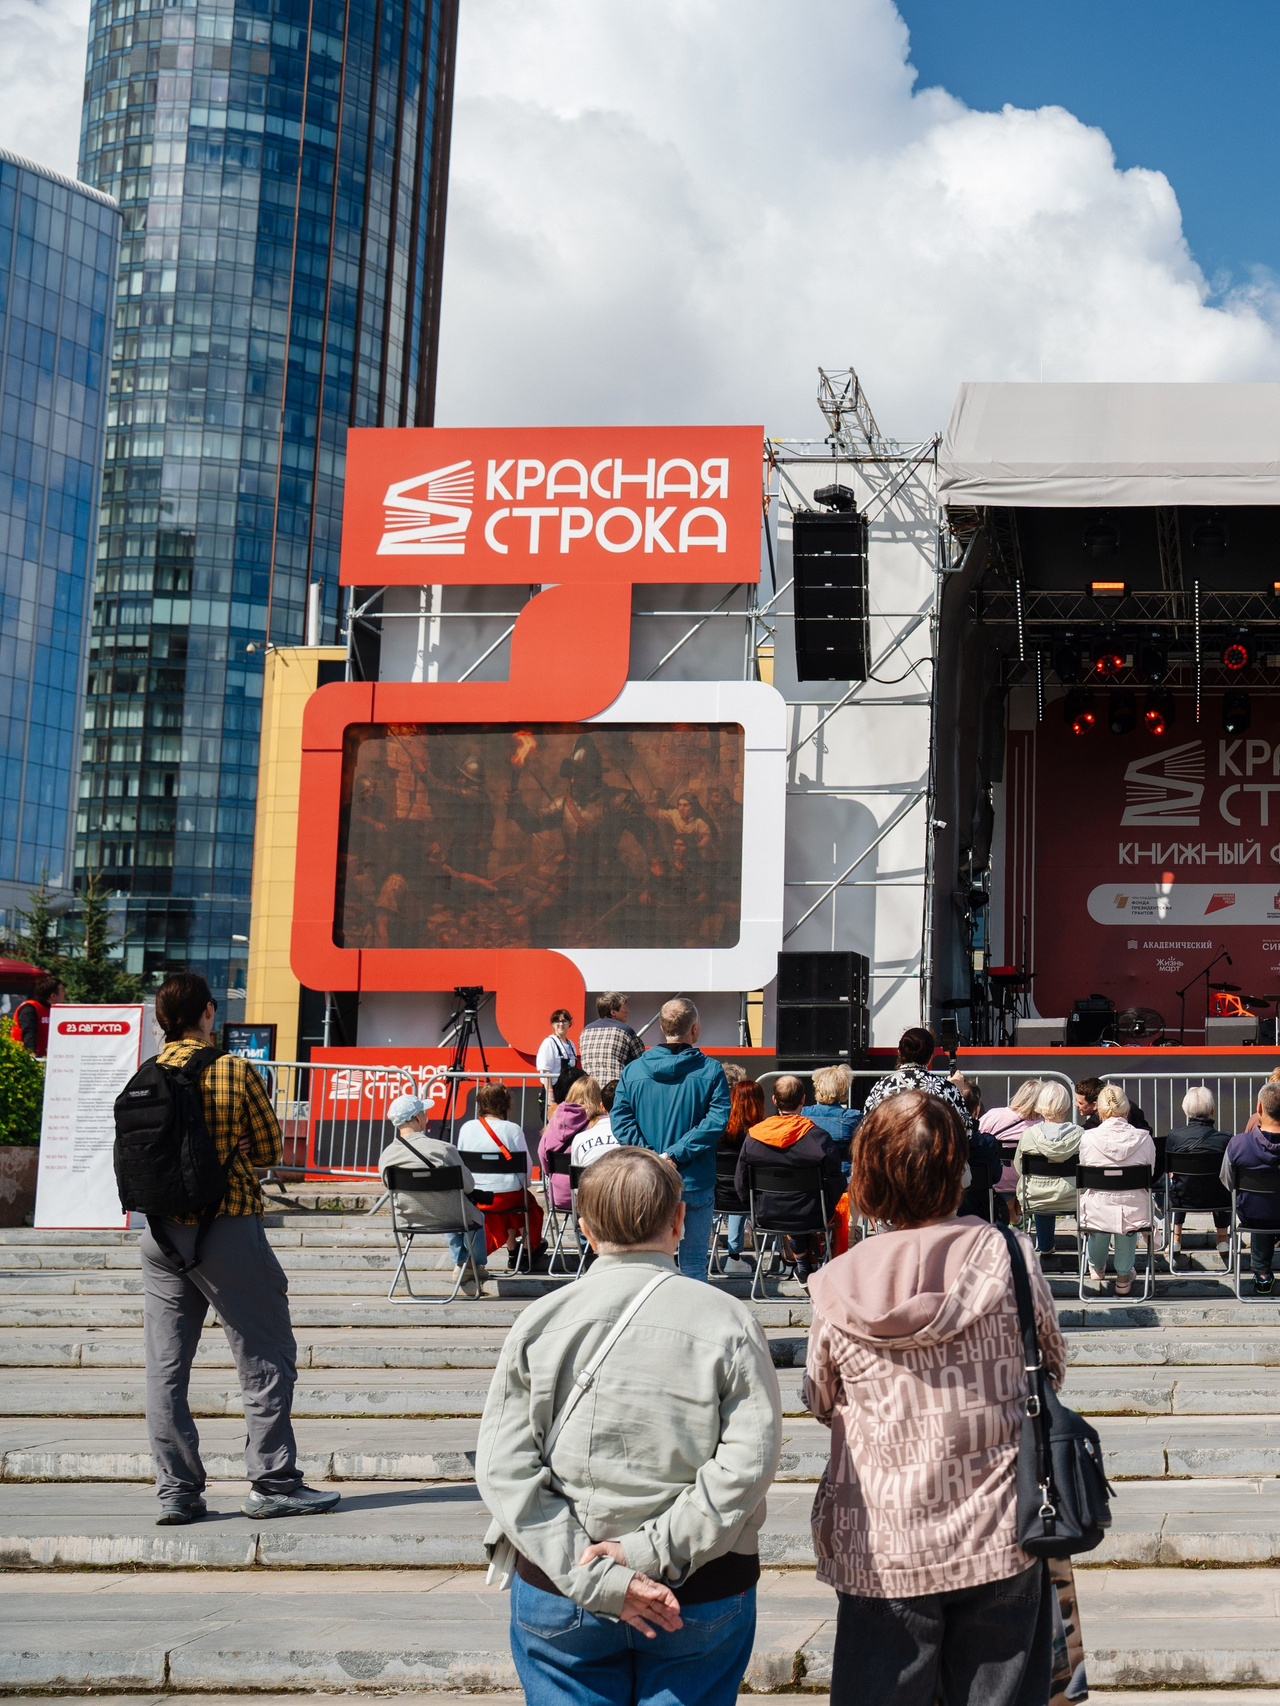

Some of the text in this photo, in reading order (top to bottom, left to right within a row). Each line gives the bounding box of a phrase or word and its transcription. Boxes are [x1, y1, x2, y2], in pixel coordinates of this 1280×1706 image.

[486, 457, 730, 500] КРАСНАЯ
[484, 506, 728, 555] СТРОКА
[1119, 838, 1262, 865] КНИЖНЫЙ
[1142, 940, 1213, 949] АКАДЕМИЧЕСКИЙ
[1156, 958, 1184, 966] Жизнь
[1159, 965, 1181, 973] март
[66, 1023, 122, 1033] 23 АВГУСТА
[581, 1135, 620, 1153] ITAL
[870, 1414, 945, 1446] NATURE
[866, 1435, 957, 1468] INSTANCE
[861, 1452, 982, 1509] NATURE
[865, 1503, 941, 1532] NATURE
